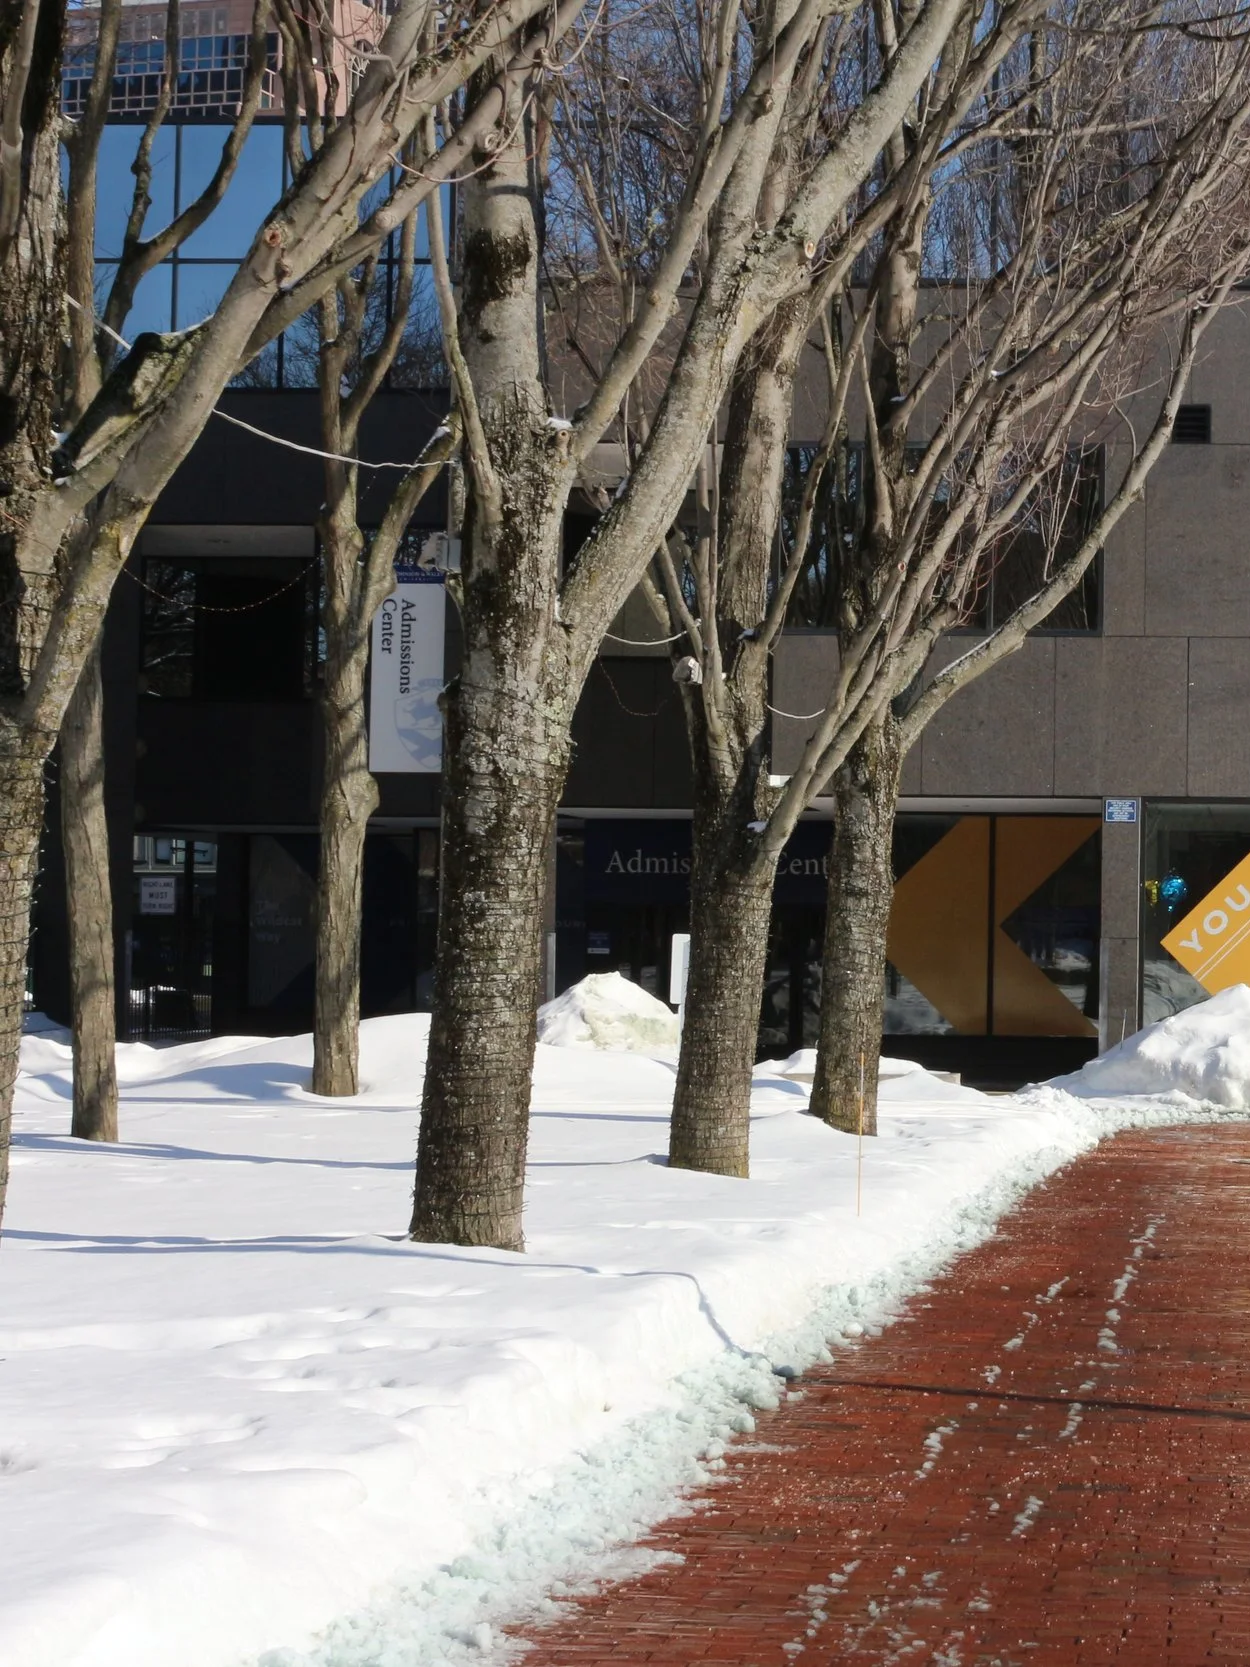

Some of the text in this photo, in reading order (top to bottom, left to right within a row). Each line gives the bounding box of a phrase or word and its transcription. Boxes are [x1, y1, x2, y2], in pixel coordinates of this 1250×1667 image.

[381, 598, 398, 655] Center
[399, 598, 417, 695] Admissions
[604, 848, 829, 876] Admis Cent
